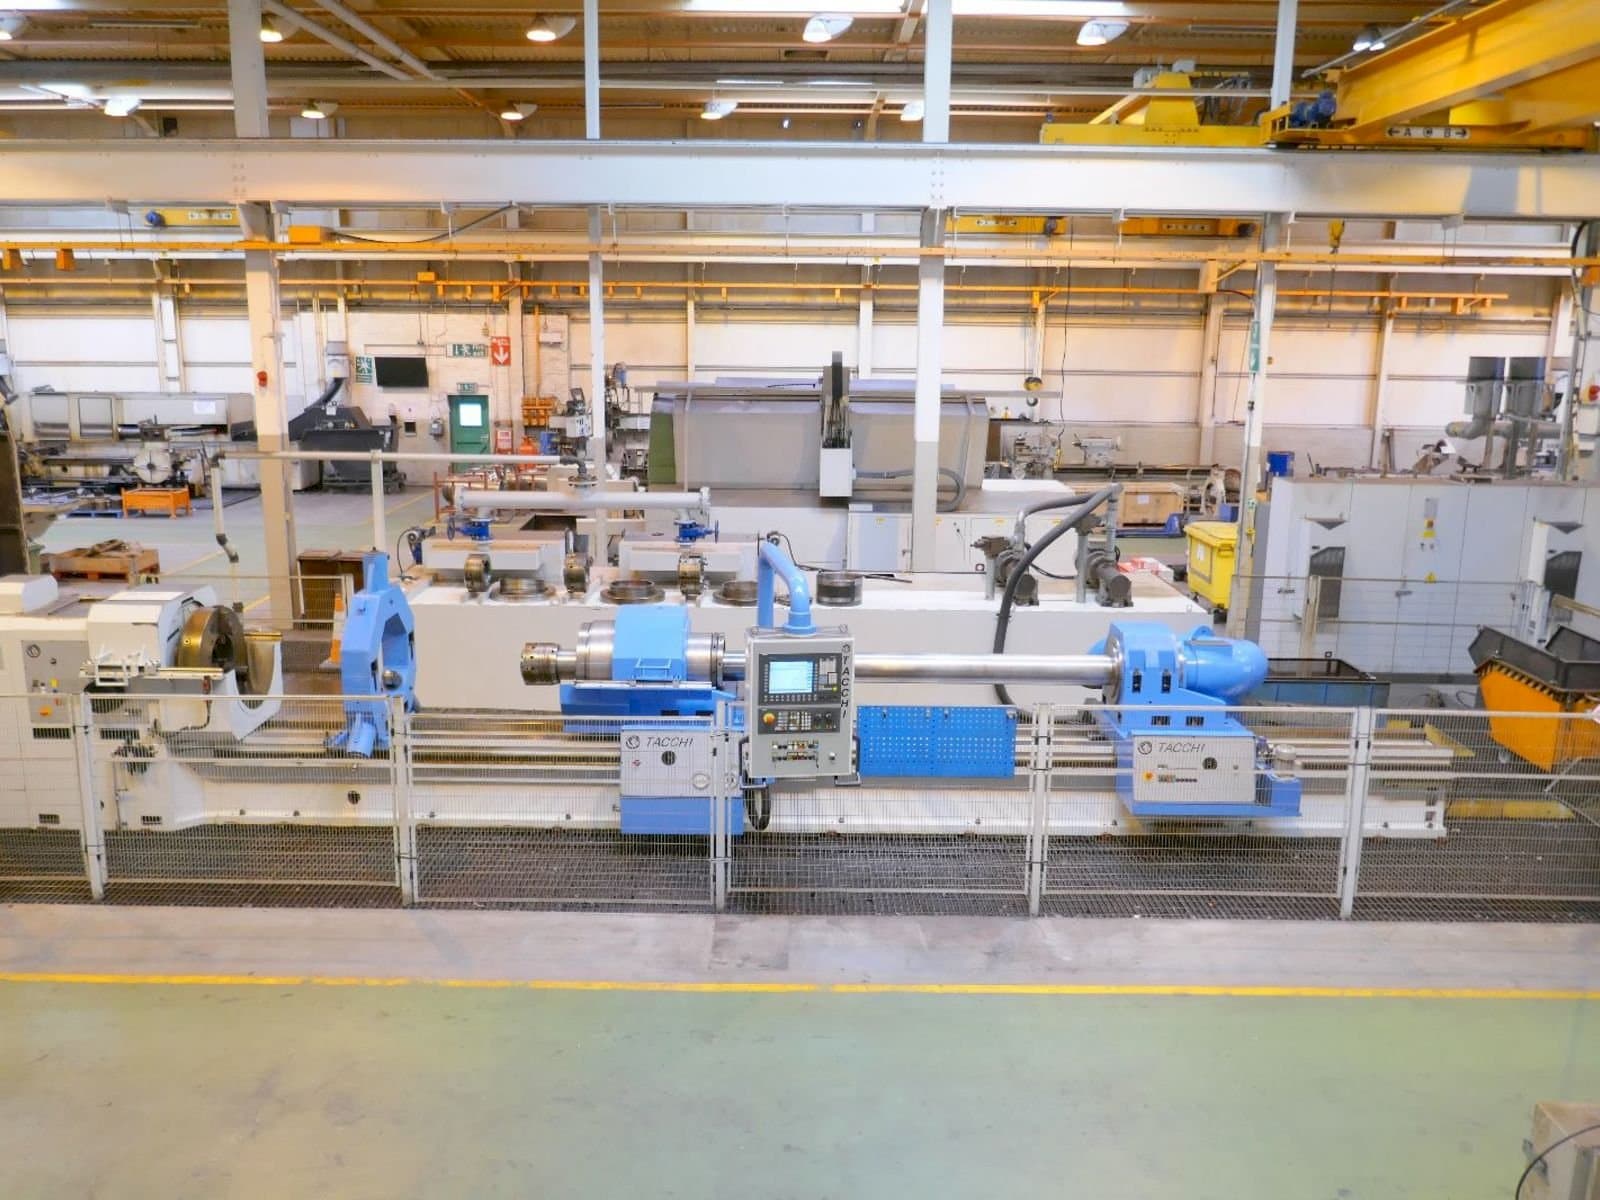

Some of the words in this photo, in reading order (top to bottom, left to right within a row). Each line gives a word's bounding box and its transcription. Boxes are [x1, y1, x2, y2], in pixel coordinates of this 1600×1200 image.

[841, 656, 850, 718] TACCHI
[647, 737, 694, 748] TACCHI
[1158, 742, 1205, 753] TACCHI
